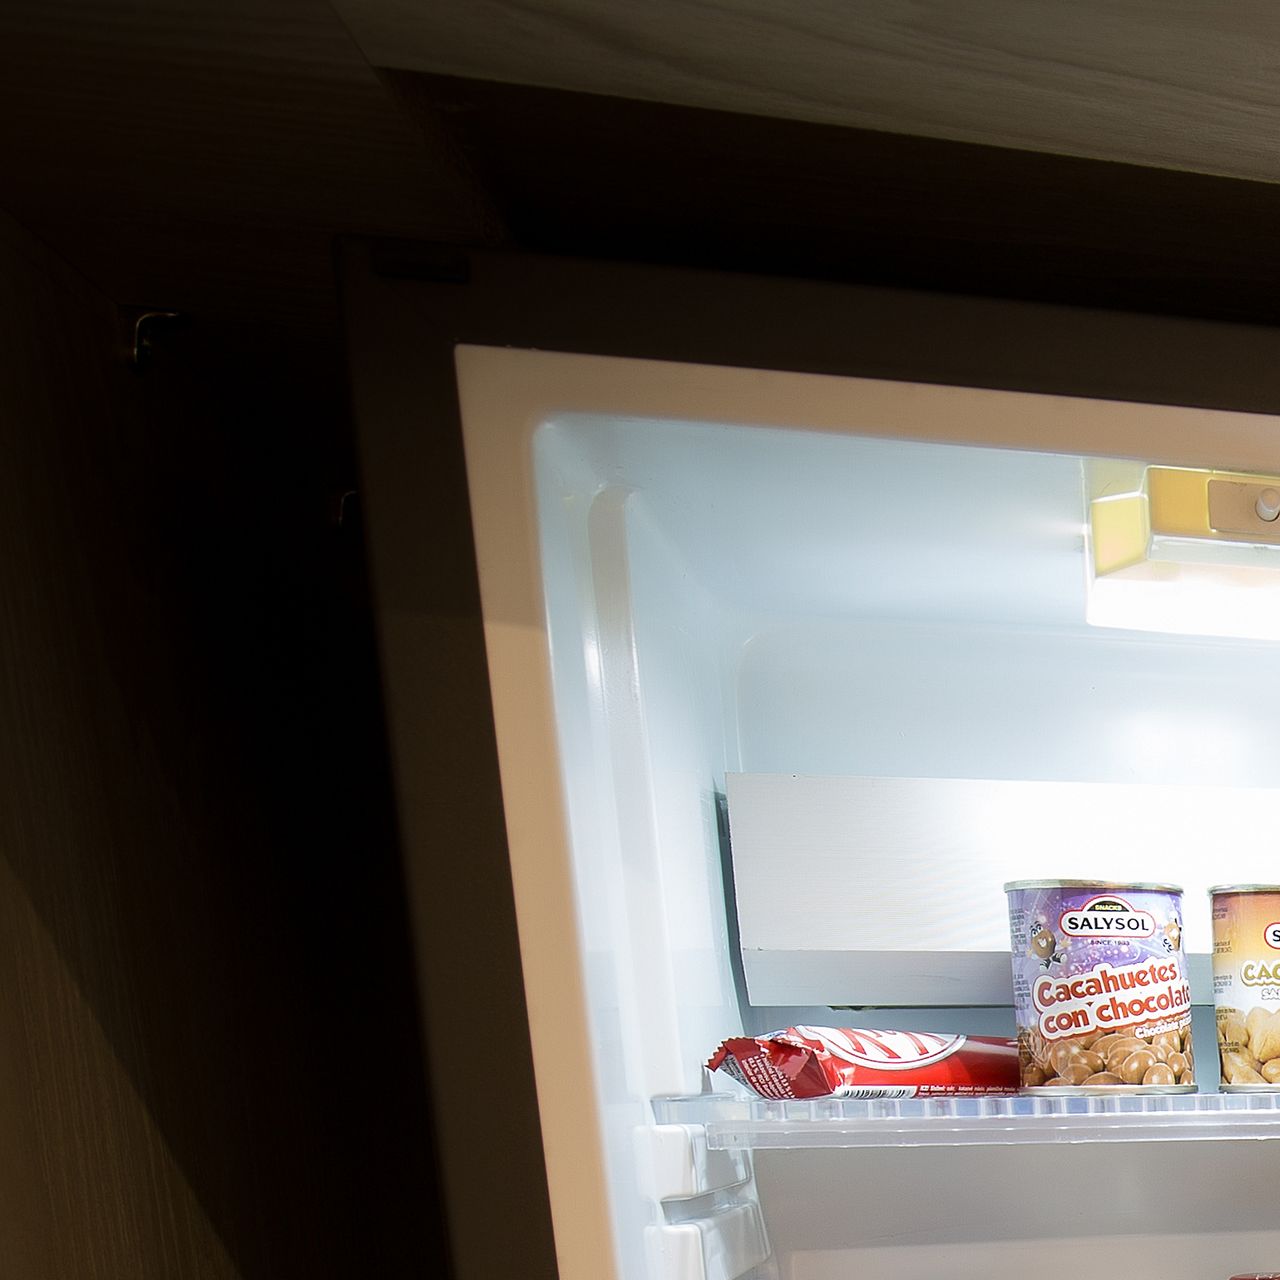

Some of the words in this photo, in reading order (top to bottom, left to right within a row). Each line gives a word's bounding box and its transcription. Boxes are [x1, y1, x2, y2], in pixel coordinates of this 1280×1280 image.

[1068, 917, 1149, 931] SALYSOL
[1038, 961, 1178, 1007] Cacahuetes
[1044, 1009, 1090, 1034] con
